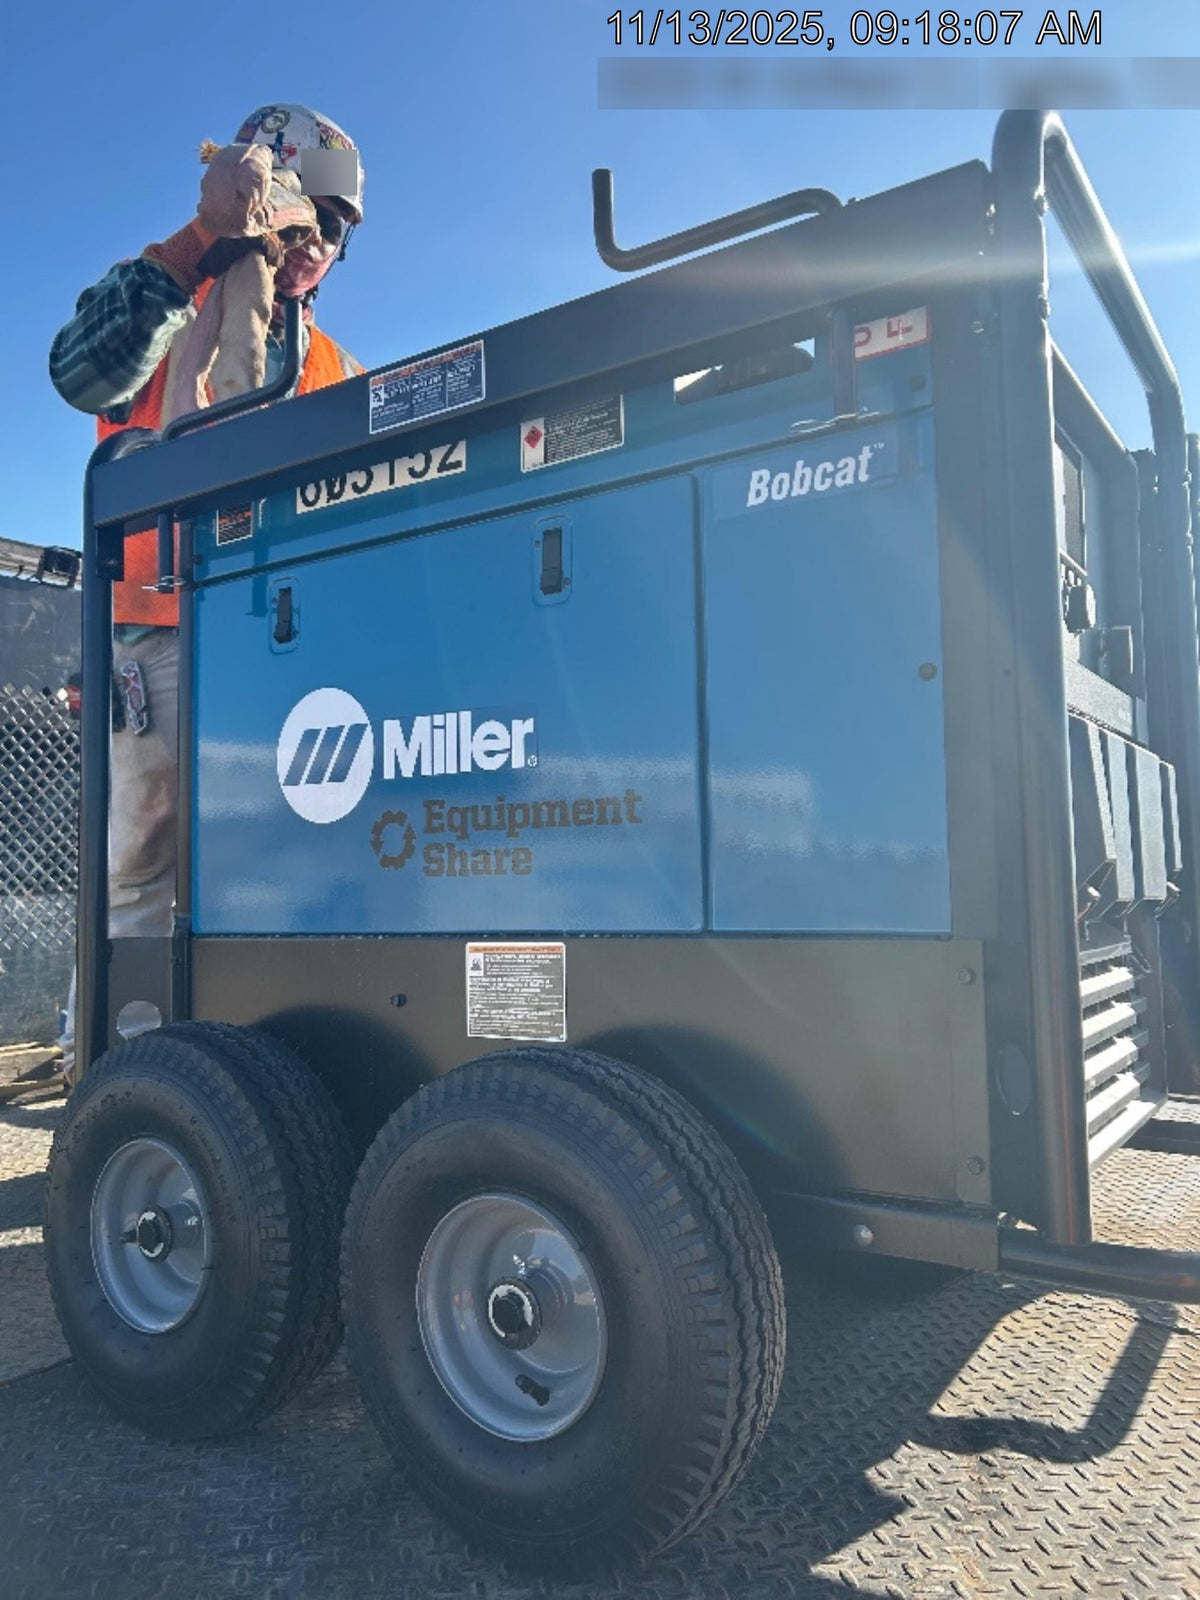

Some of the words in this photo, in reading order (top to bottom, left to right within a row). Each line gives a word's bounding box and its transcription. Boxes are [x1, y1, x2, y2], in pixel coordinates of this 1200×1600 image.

[383, 710, 534, 780] Miller
[423, 789, 643, 839] Equipment
[422, 842, 533, 877] Share
